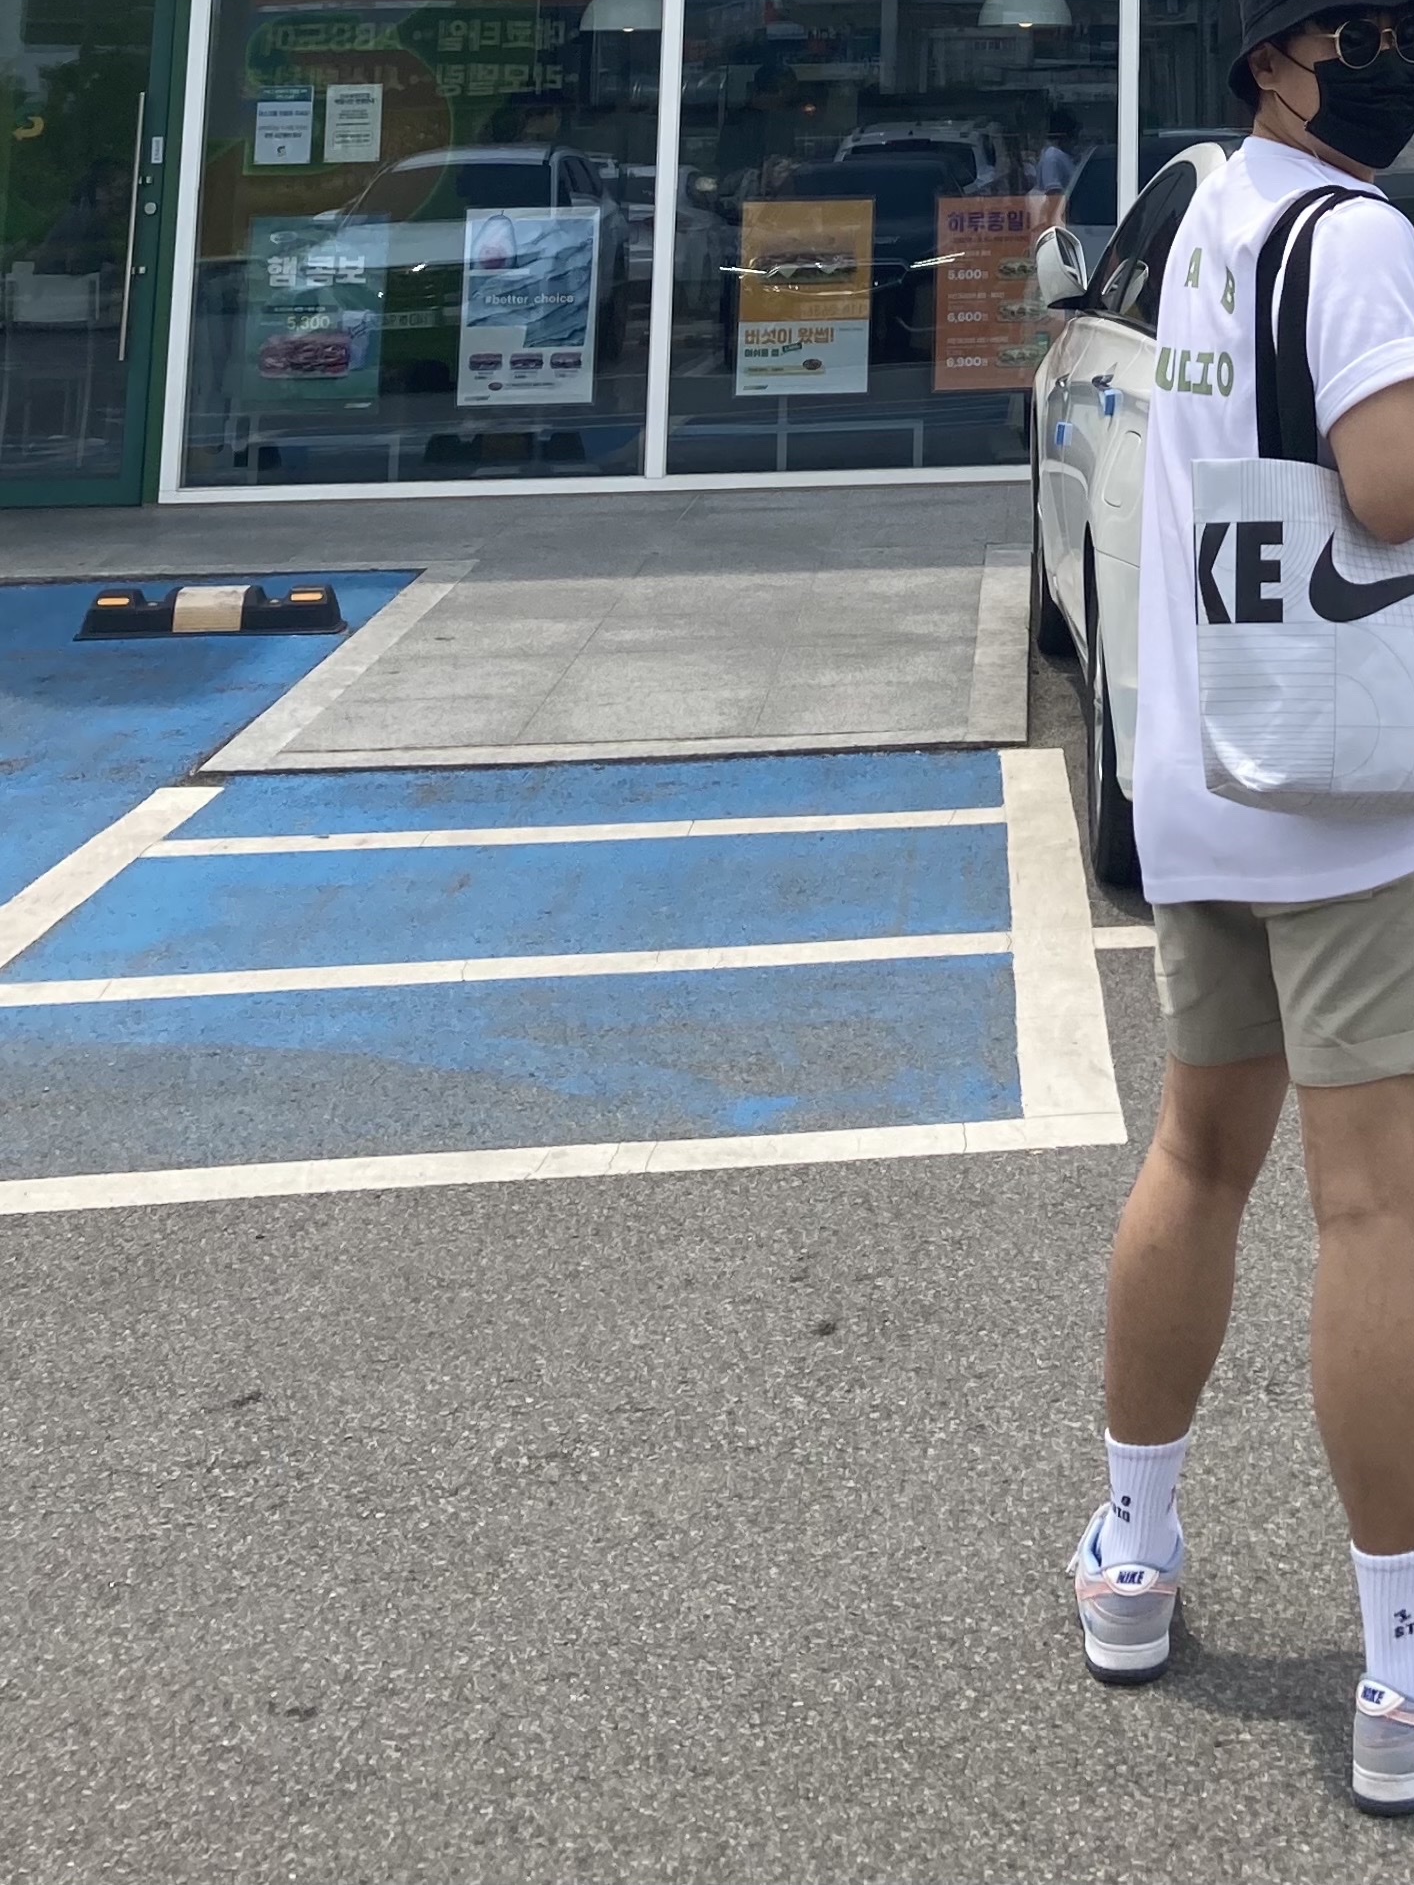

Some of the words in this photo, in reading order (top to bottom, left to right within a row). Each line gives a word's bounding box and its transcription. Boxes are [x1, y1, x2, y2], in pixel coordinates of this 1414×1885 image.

[267, 256, 298, 287] 햄
[1183, 247, 1202, 289] A
[744, 327, 793, 345] 버섯이
[1115, 1571, 1145, 1585] NIKE
[1360, 1686, 1386, 1705] NIKE
